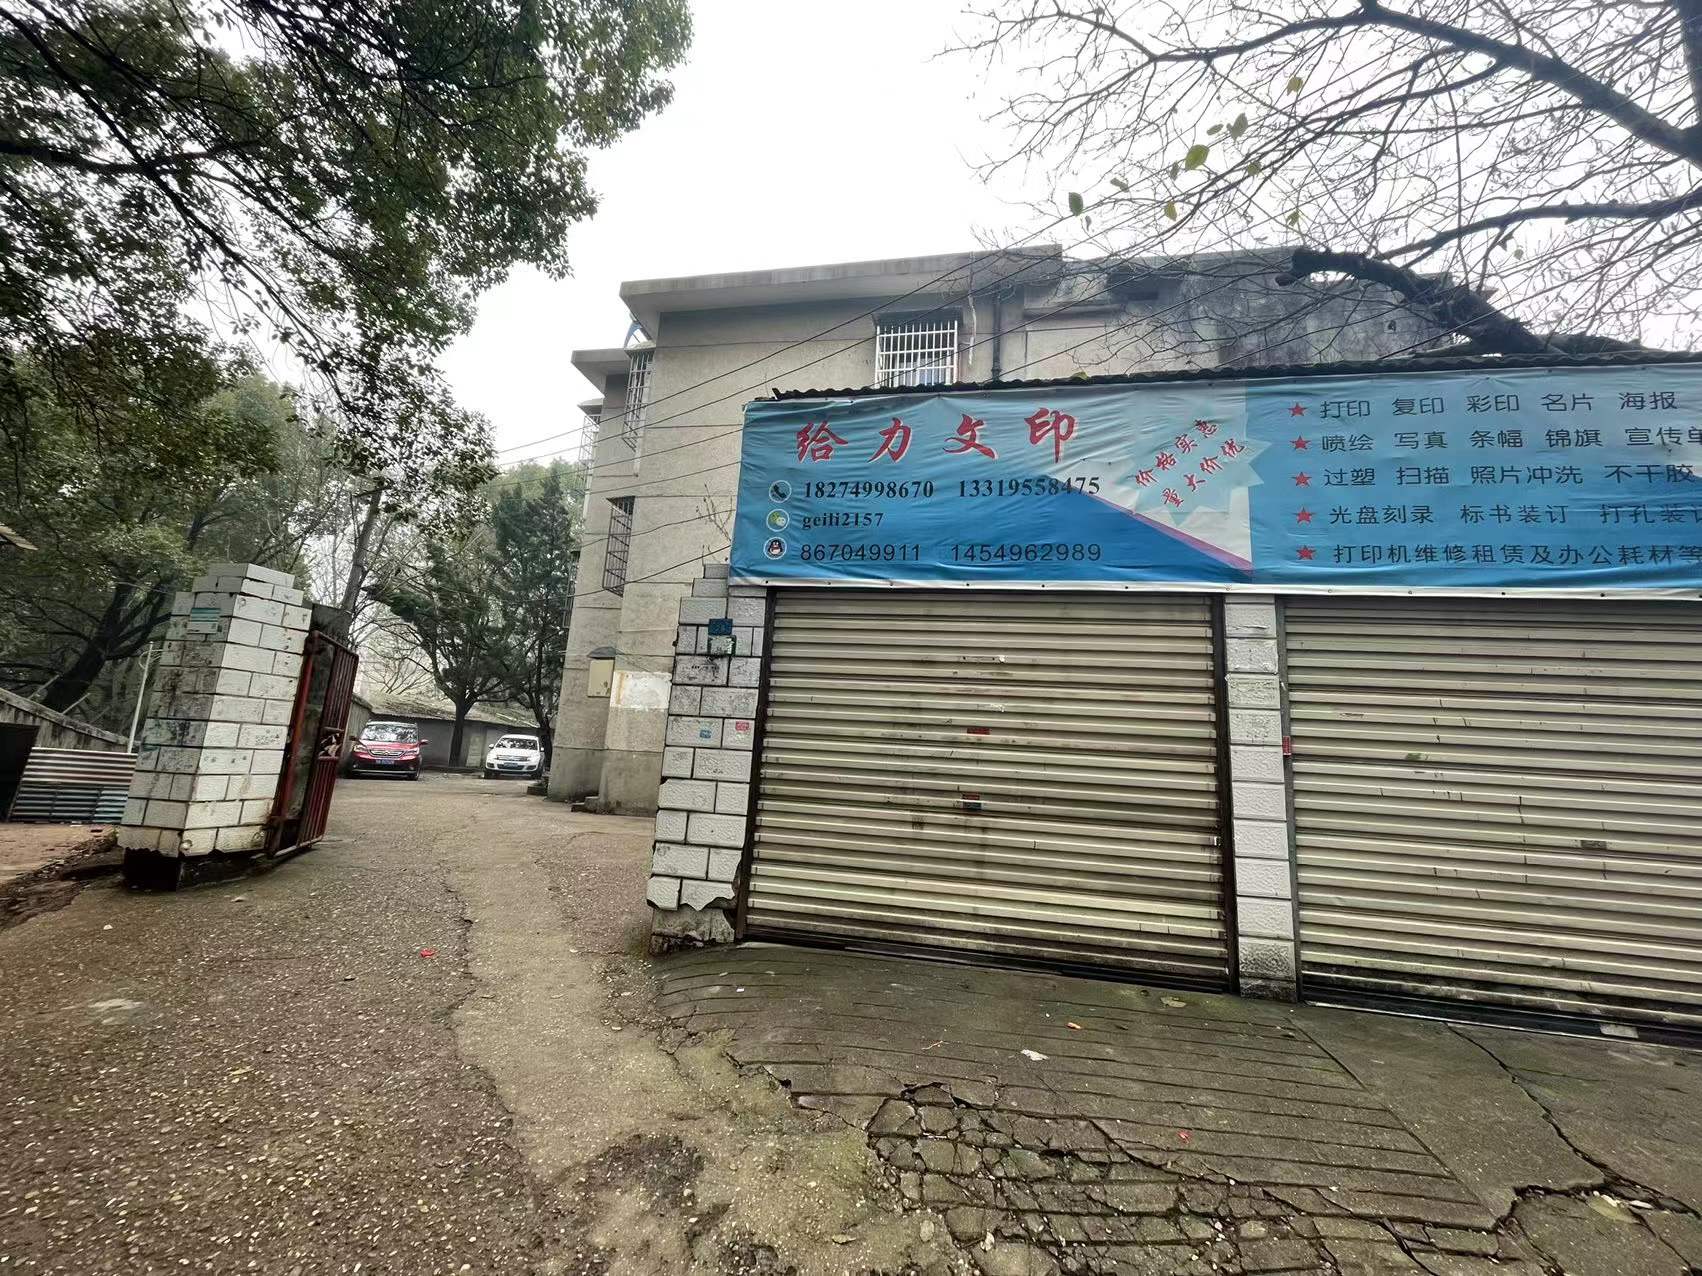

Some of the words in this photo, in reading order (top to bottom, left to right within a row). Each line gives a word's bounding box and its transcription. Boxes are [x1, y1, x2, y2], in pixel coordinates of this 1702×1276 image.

[1319, 399, 1371, 419] 打印
[1392, 397, 1445, 416] 复印
[1467, 394, 1521, 414] 彩印
[1541, 392, 1595, 411] 名片
[1618, 391, 1678, 410] 海报
[796, 407, 1079, 463] 给力文印
[1322, 433, 1375, 452] 喷绘
[1394, 431, 1447, 449] 写真
[1471, 430, 1524, 449] 条幅
[1546, 428, 1603, 448] 锦旗
[1323, 468, 1377, 487] 过塑
[1396, 467, 1450, 486] 扫描
[1471, 465, 1583, 485] 照片冲洗
[1604, 463, 1697, 484] 不干胶
[805, 480, 934, 498] 18274998670
[959, 477, 1101, 497] 13319558475
[802, 512, 884, 529] geili2157
[1329, 504, 1435, 525] 光盘刻录
[1460, 503, 1569, 524] 标书装订
[801, 544, 920, 561] 867049911
[951, 543, 1101, 562] 1454962989
[1333, 543, 1702, 566] 打印机维修租赁及办公耗材等
